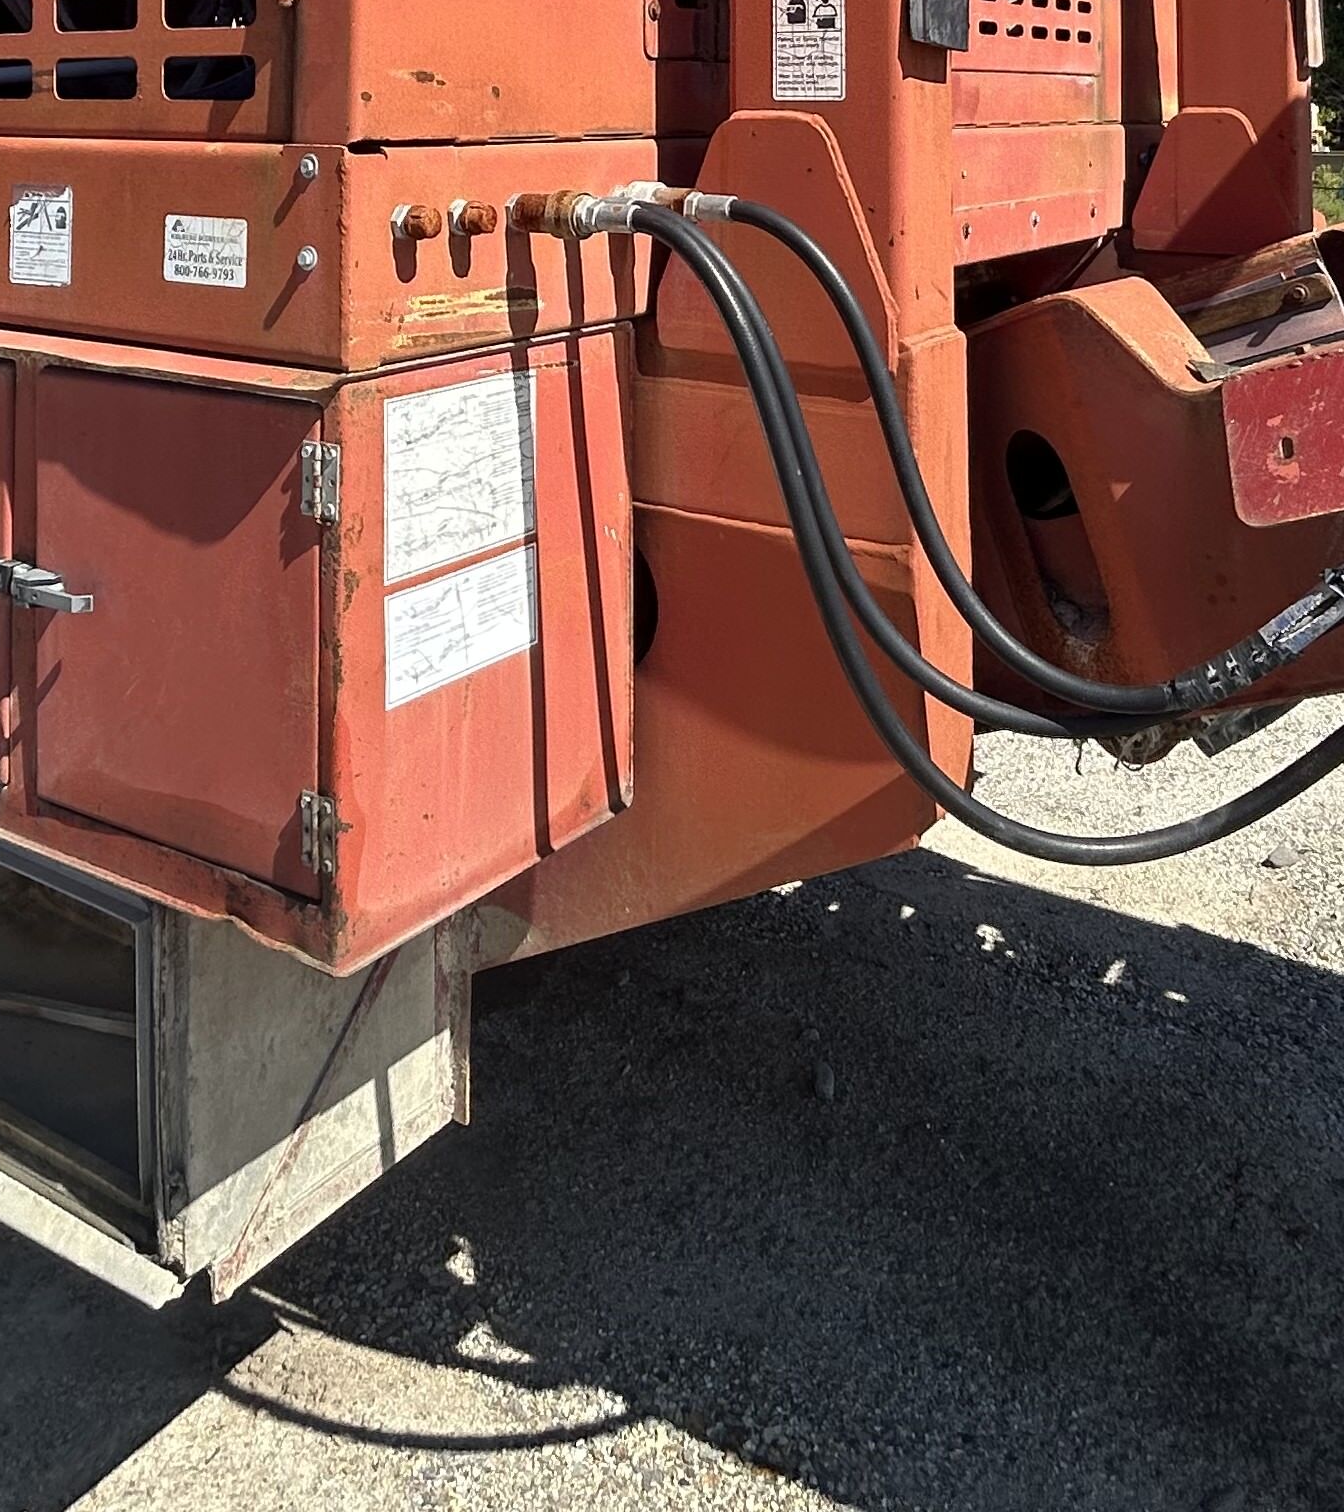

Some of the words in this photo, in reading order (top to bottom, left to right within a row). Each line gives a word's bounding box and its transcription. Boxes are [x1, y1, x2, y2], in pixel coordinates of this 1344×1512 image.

[168, 248, 177, 261] 24
[188, 249, 208, 264] Parts
[208, 251, 215, 264] &
[215, 252, 243, 267] Service
[173, 263, 235, 281] 800-766-9793
